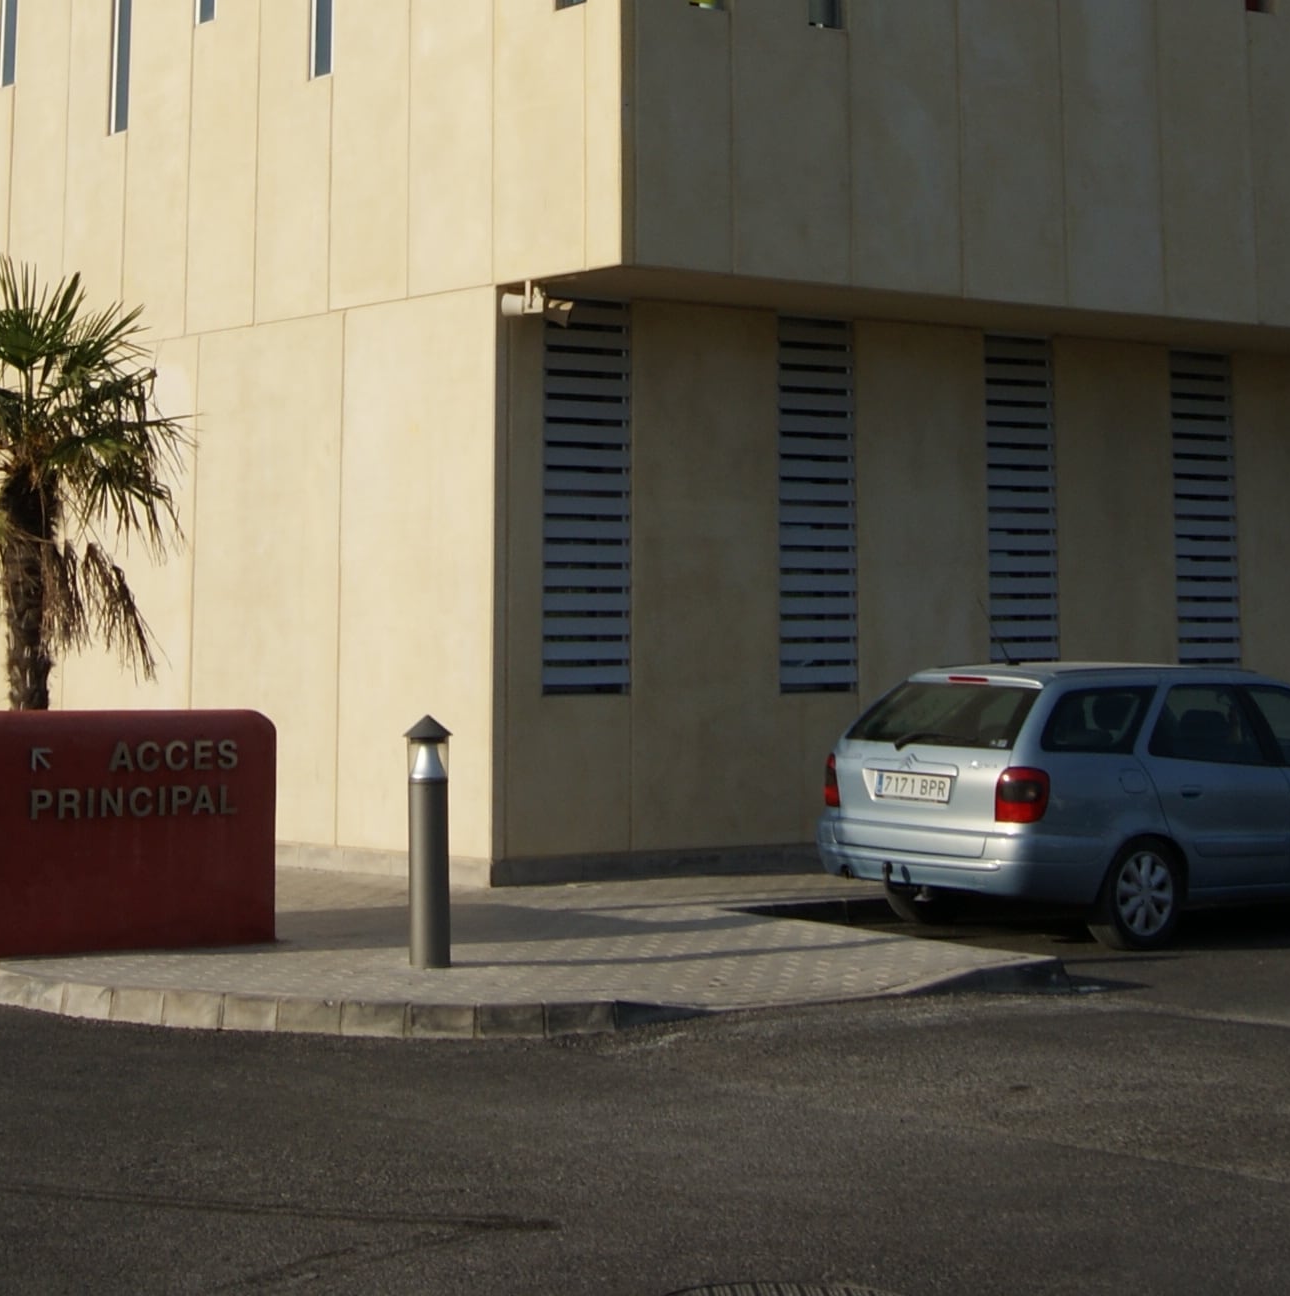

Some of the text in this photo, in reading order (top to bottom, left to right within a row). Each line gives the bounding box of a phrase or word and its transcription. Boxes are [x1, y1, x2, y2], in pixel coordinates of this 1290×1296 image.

[108, 739, 239, 772] ACCES
[29, 784, 239, 821] PRINCIPAL
[883, 775, 947, 798] 7171 BPR
